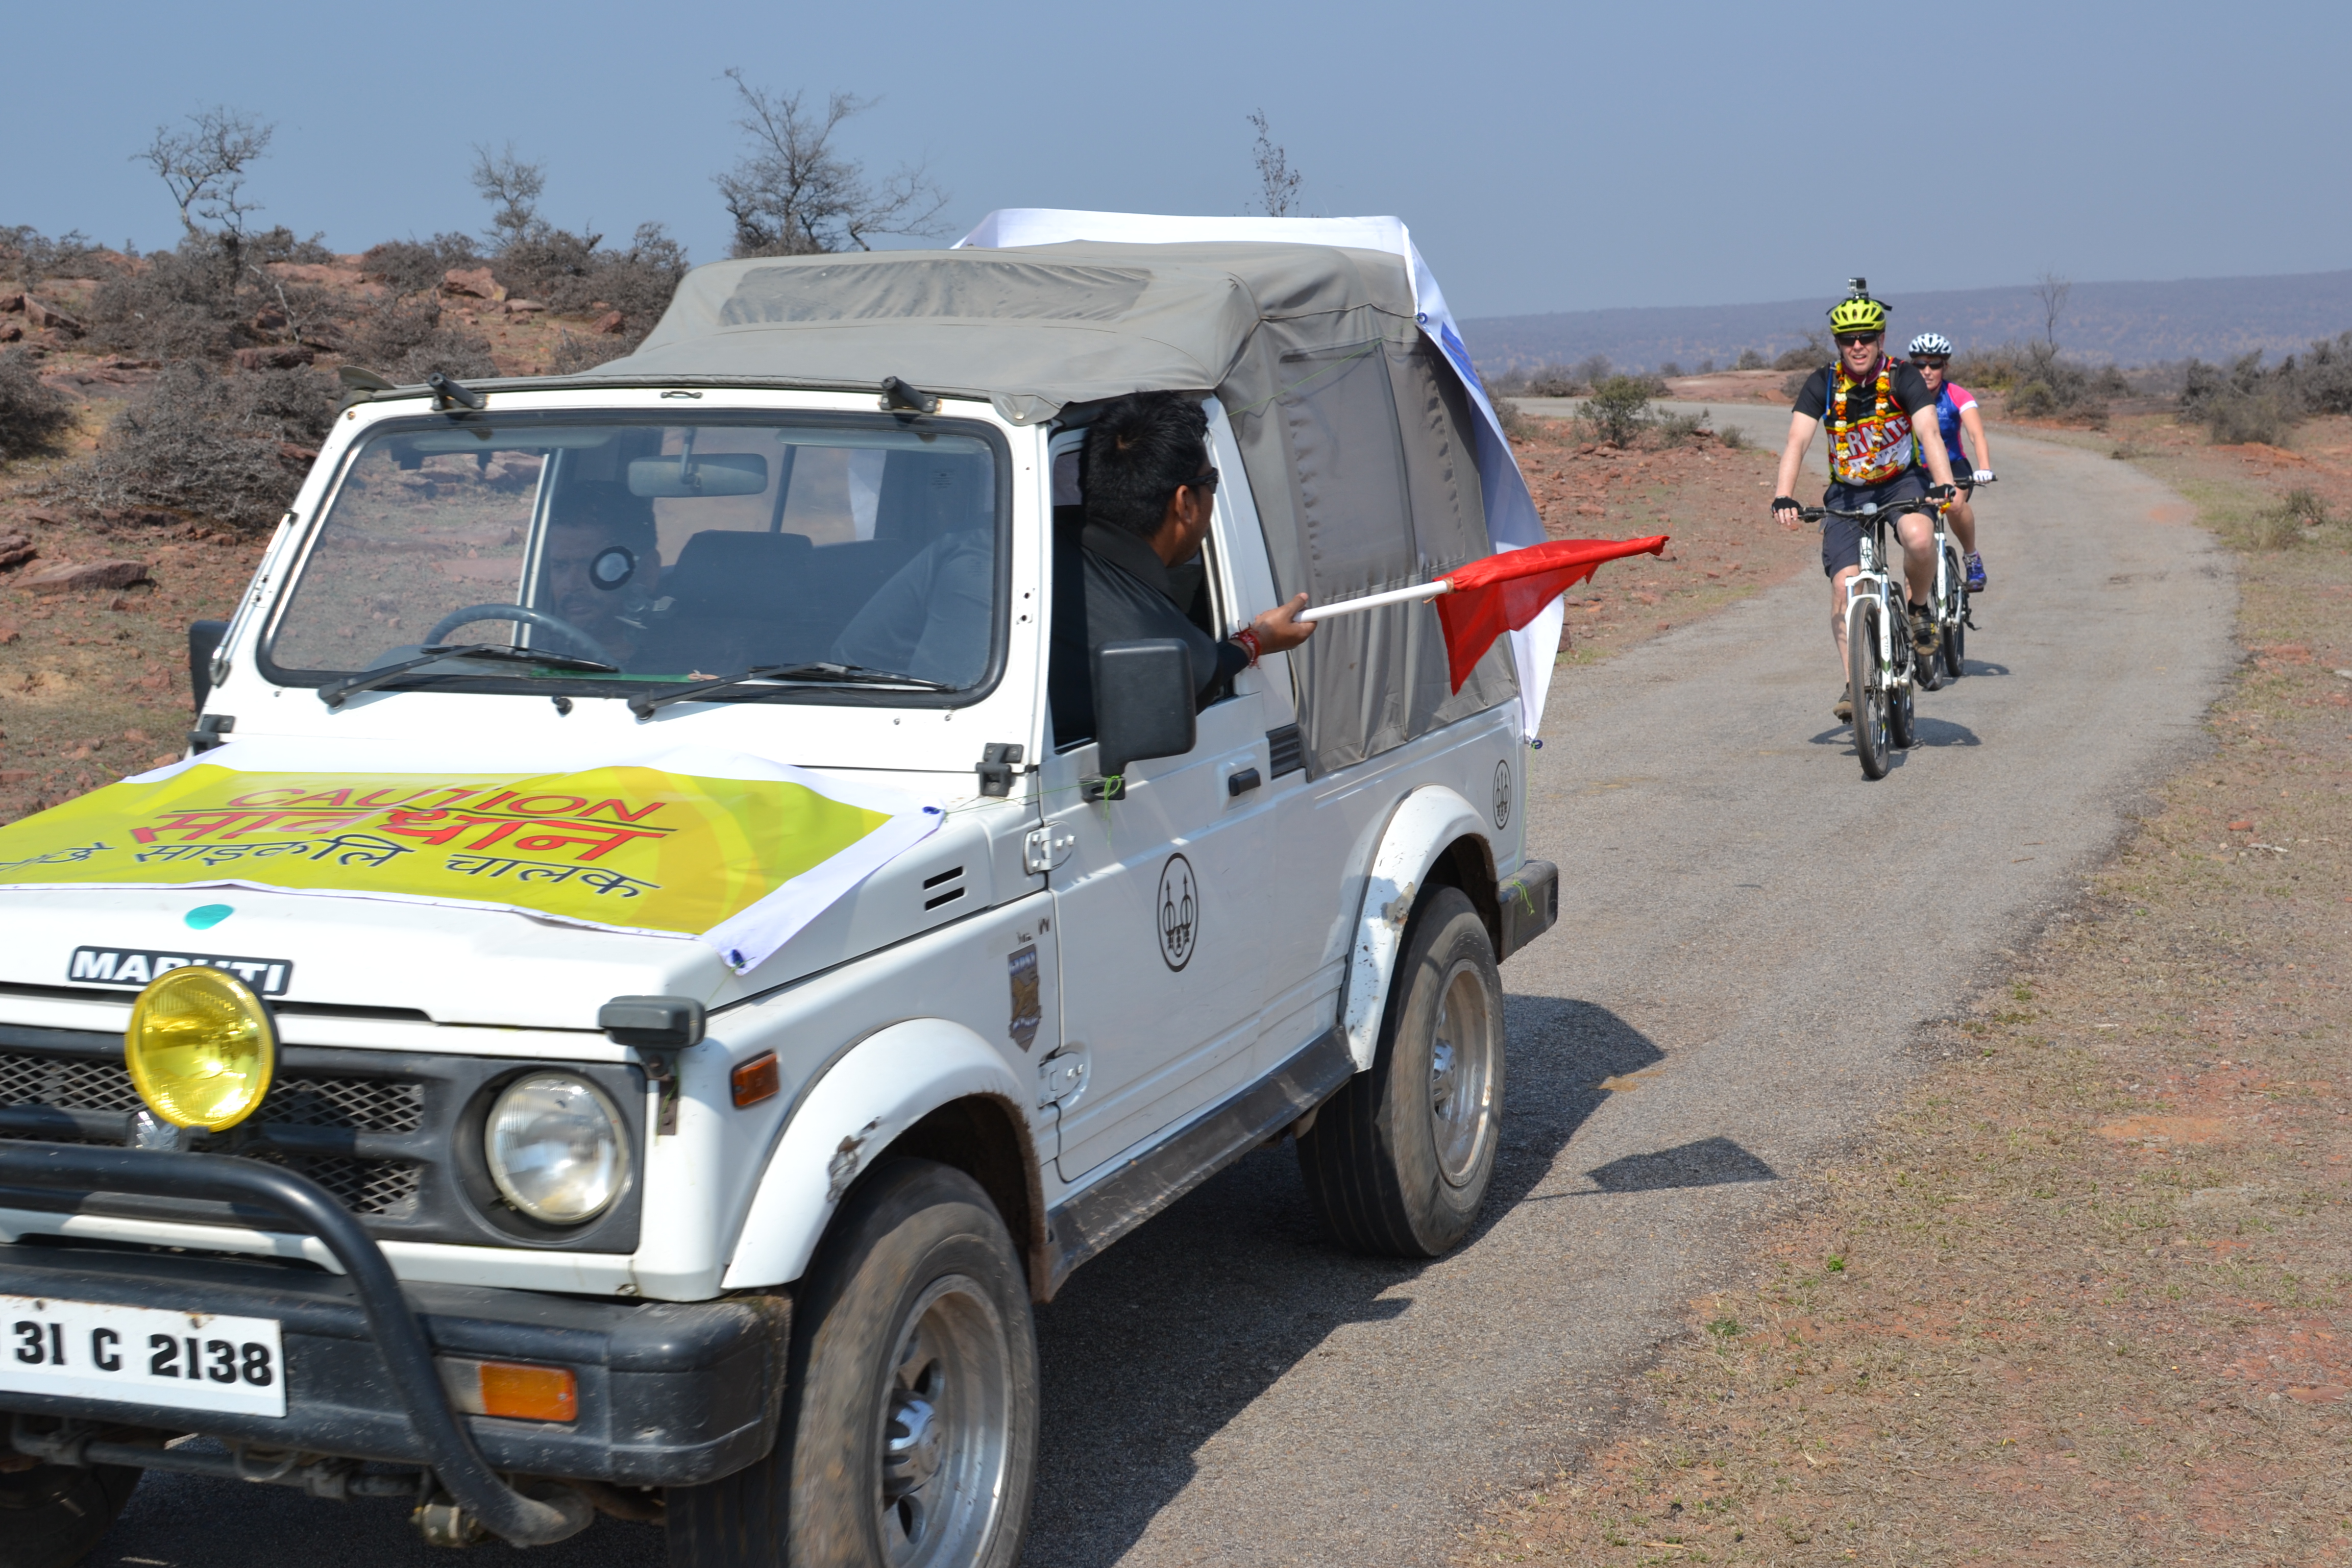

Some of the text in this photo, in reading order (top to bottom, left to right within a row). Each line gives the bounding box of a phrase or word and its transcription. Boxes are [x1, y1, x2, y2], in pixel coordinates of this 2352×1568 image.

[227, 788, 667, 822] CAUTION
[130, 808, 668, 862] सावधान
[71, 950, 286, 992] MARTI
[14, 1320, 67, 1365] 31
[148, 1333, 273, 1387] 2138
